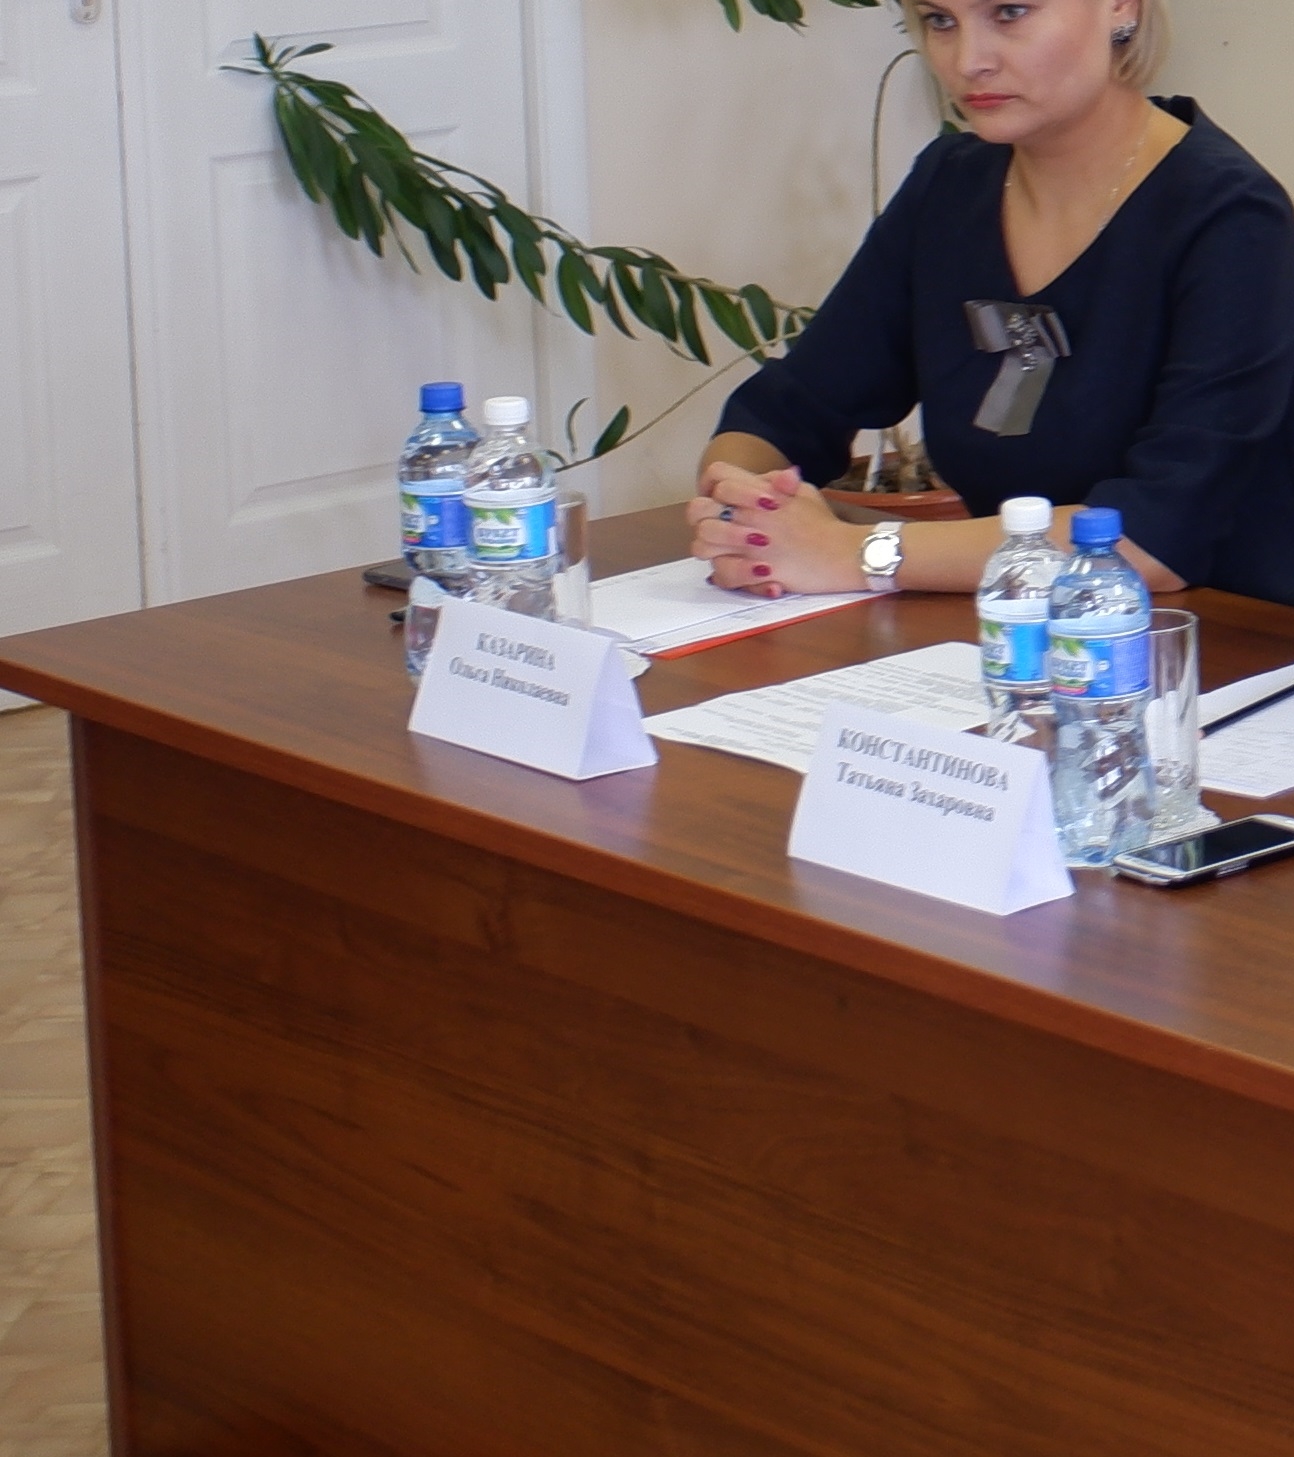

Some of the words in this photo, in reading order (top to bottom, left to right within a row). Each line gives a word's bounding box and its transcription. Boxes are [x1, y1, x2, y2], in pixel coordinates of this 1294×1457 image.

[837, 728, 1010, 792] КОНСТАНТИНОВА
[837, 761, 905, 798] Татьяна
[910, 780, 997, 822] Захаровна
